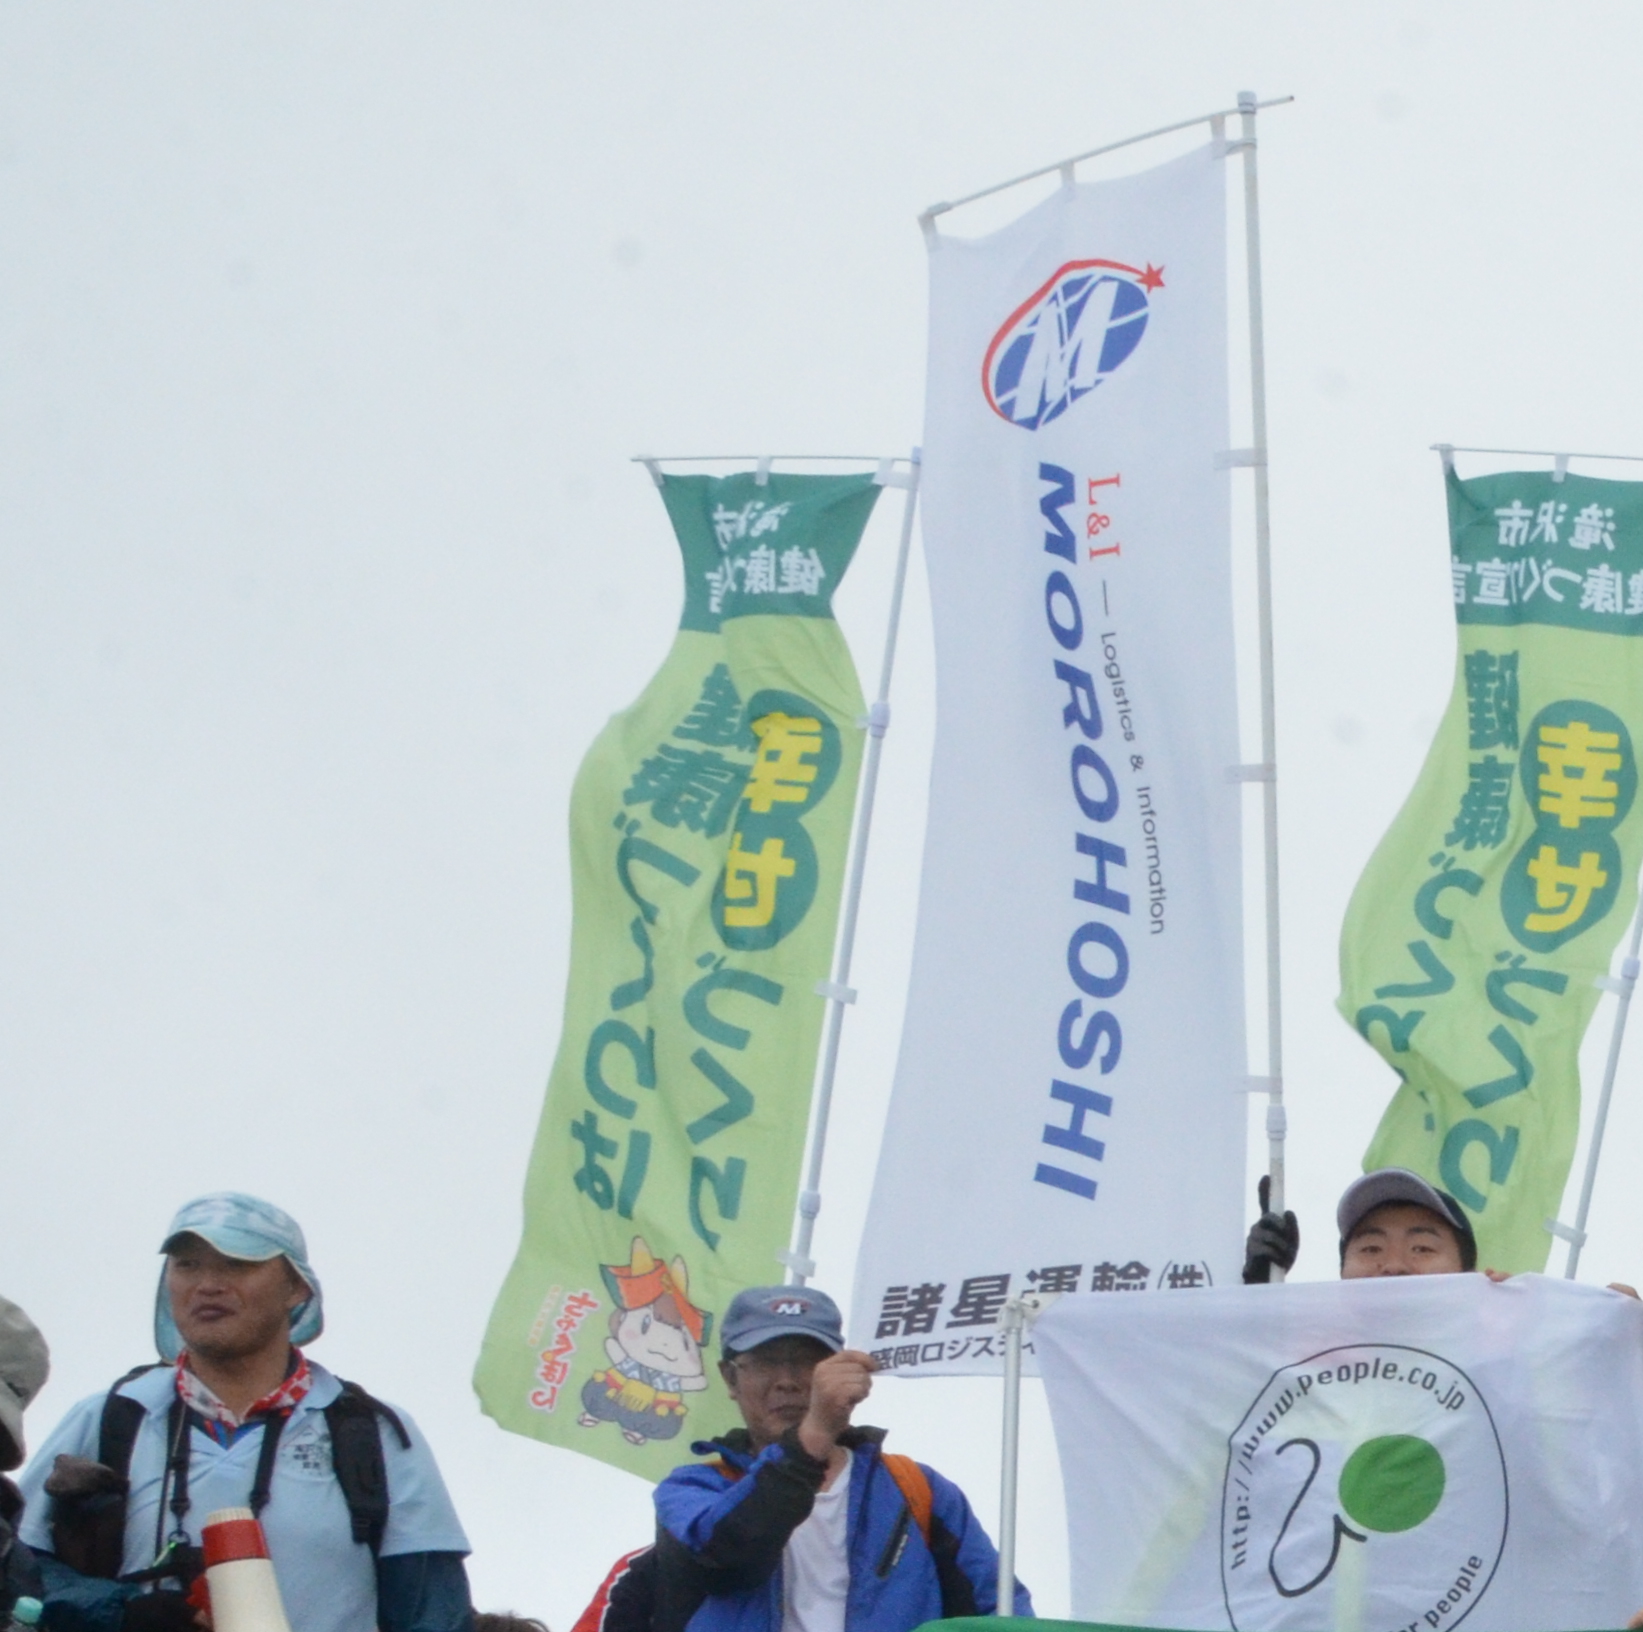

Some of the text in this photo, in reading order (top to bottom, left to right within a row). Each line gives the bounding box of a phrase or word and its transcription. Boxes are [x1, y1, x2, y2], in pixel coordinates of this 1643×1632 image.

[1086, 472, 1122, 562] L&I
[1034, 462, 1132, 1202] MOROHOSHI
[1101, 631, 1167, 937] Logistics & Information
[1230, 1357, 1467, 1570] http://www.people.co.jp
[1423, 1553, 1484, 1630] people
